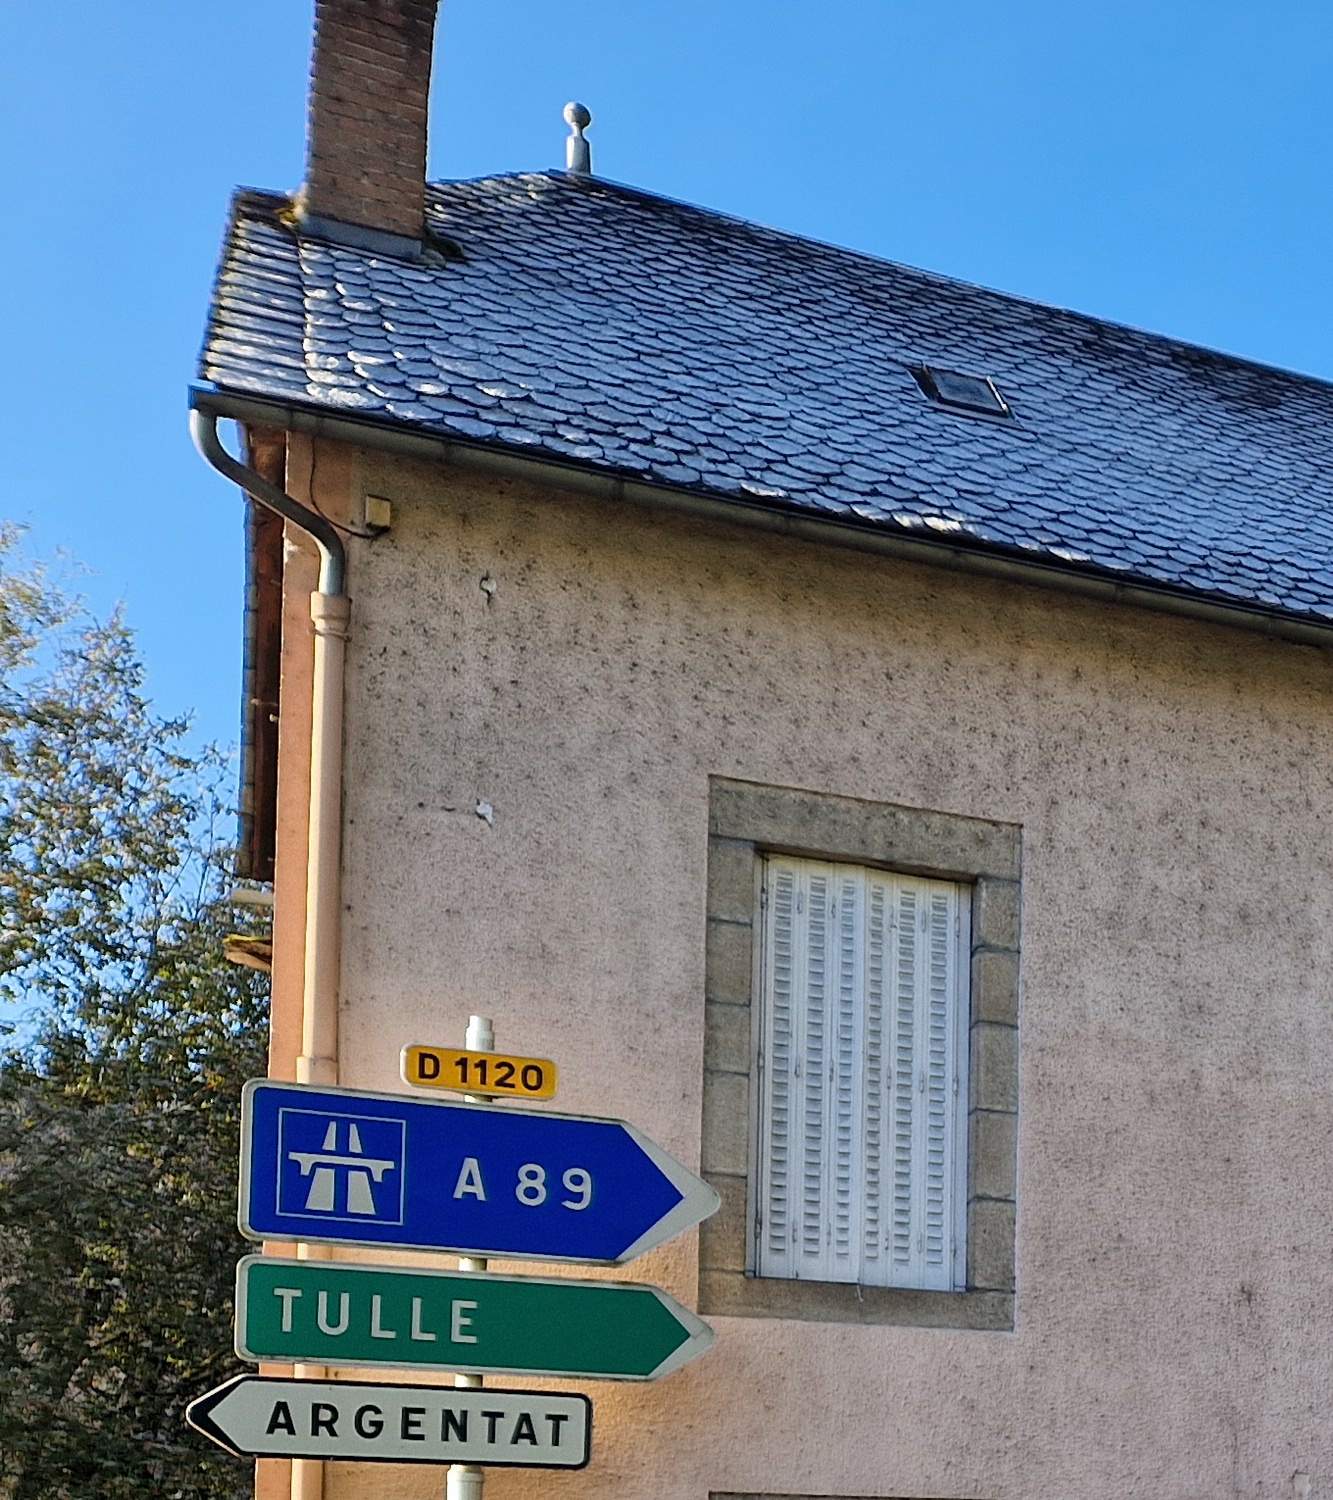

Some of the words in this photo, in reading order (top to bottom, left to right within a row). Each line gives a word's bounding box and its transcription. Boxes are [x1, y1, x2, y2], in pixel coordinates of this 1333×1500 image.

[417, 1053, 440, 1081] D
[455, 1057, 544, 1092] 1120
[453, 1158, 487, 1202] A
[514, 1163, 593, 1211] 89
[273, 1288, 479, 1344] TULLE
[266, 1400, 569, 1448] ARGENTAT
